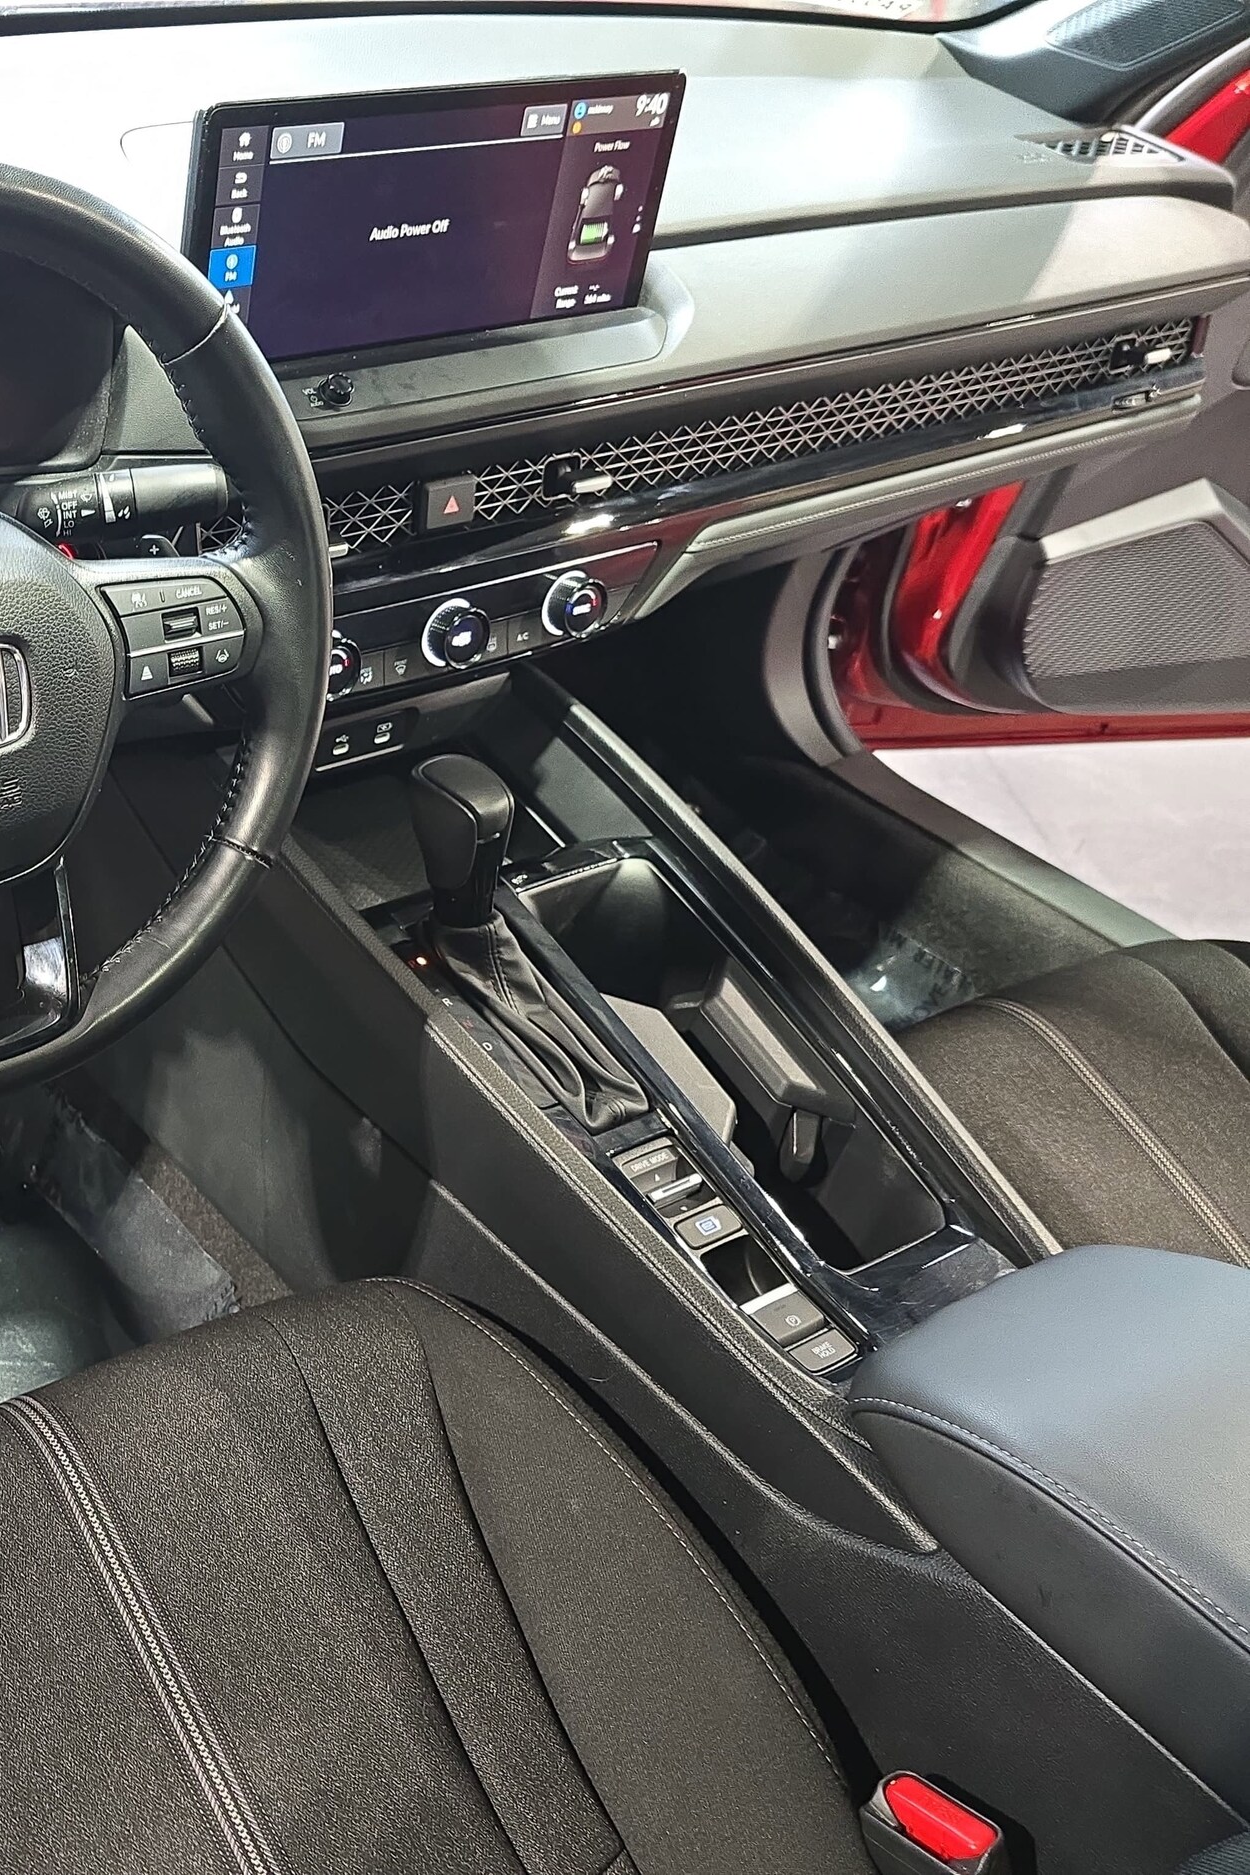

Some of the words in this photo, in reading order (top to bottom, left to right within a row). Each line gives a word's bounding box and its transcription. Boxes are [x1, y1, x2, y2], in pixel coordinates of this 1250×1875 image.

[635, 93, 669, 117] 9:40
[541, 115, 560, 126] Menu
[307, 131, 327, 148] FM
[593, 142, 614, 153] Power
[614, 140, 630, 151] Flow
[232, 150, 254, 162] Home
[231, 188, 248, 199] Back
[369, 226, 399, 241] Audio
[400, 223, 431, 238] Power
[432, 218, 450, 233] Off
[224, 271, 237, 282] FM
[58, 490, 78, 501] MIST
[61, 500, 77, 510] OFF
[63, 510, 77, 520] INT
[63, 520, 75, 529] LO
[63, 529, 72, 537] HI
[175, 587, 202, 599] CANCEL
[442, 997, 453, 1007] R
[482, 1042, 493, 1051] D
[630, 1160, 651, 1172] DRIVE
[649, 1152, 669, 1164] MODE
[811, 1341, 833, 1355] BRAKE
[818, 1348, 836, 1359] HOLD
